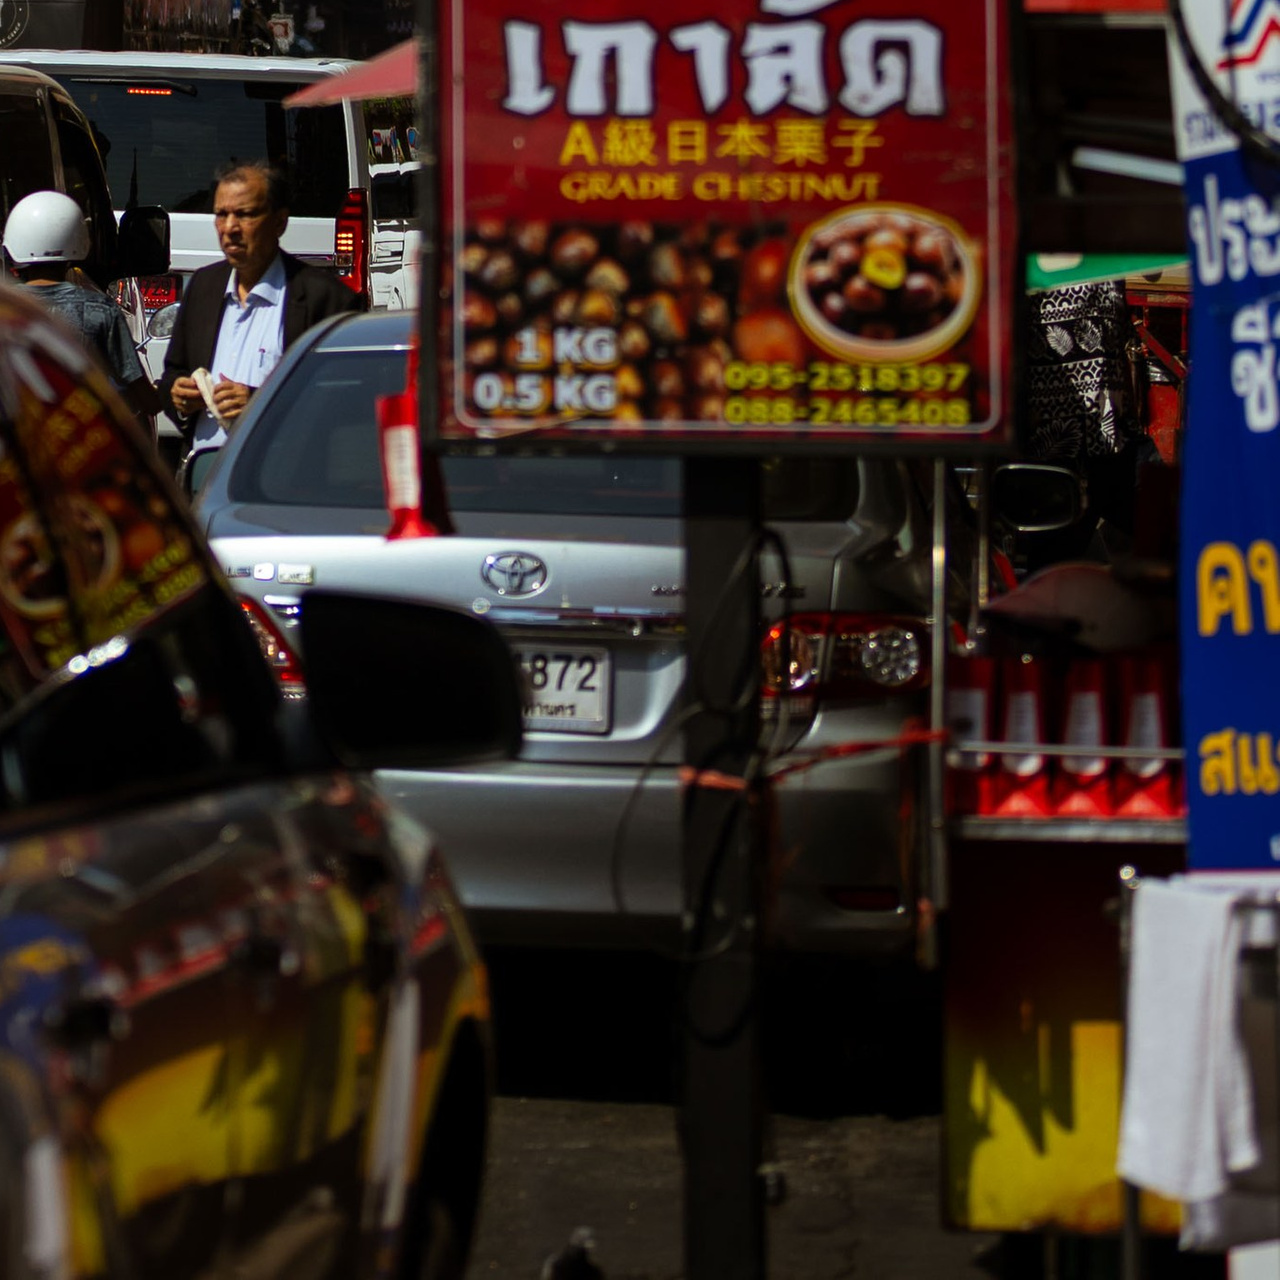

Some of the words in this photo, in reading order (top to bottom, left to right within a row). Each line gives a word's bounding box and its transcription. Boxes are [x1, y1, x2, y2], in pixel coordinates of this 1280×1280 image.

[558, 170, 683, 203] GRADE
[691, 170, 885, 203] CHESTNUT
[554, 326, 619, 365] KG
[472, 373, 545, 410] 0.5
[554, 373, 619, 412] KG
